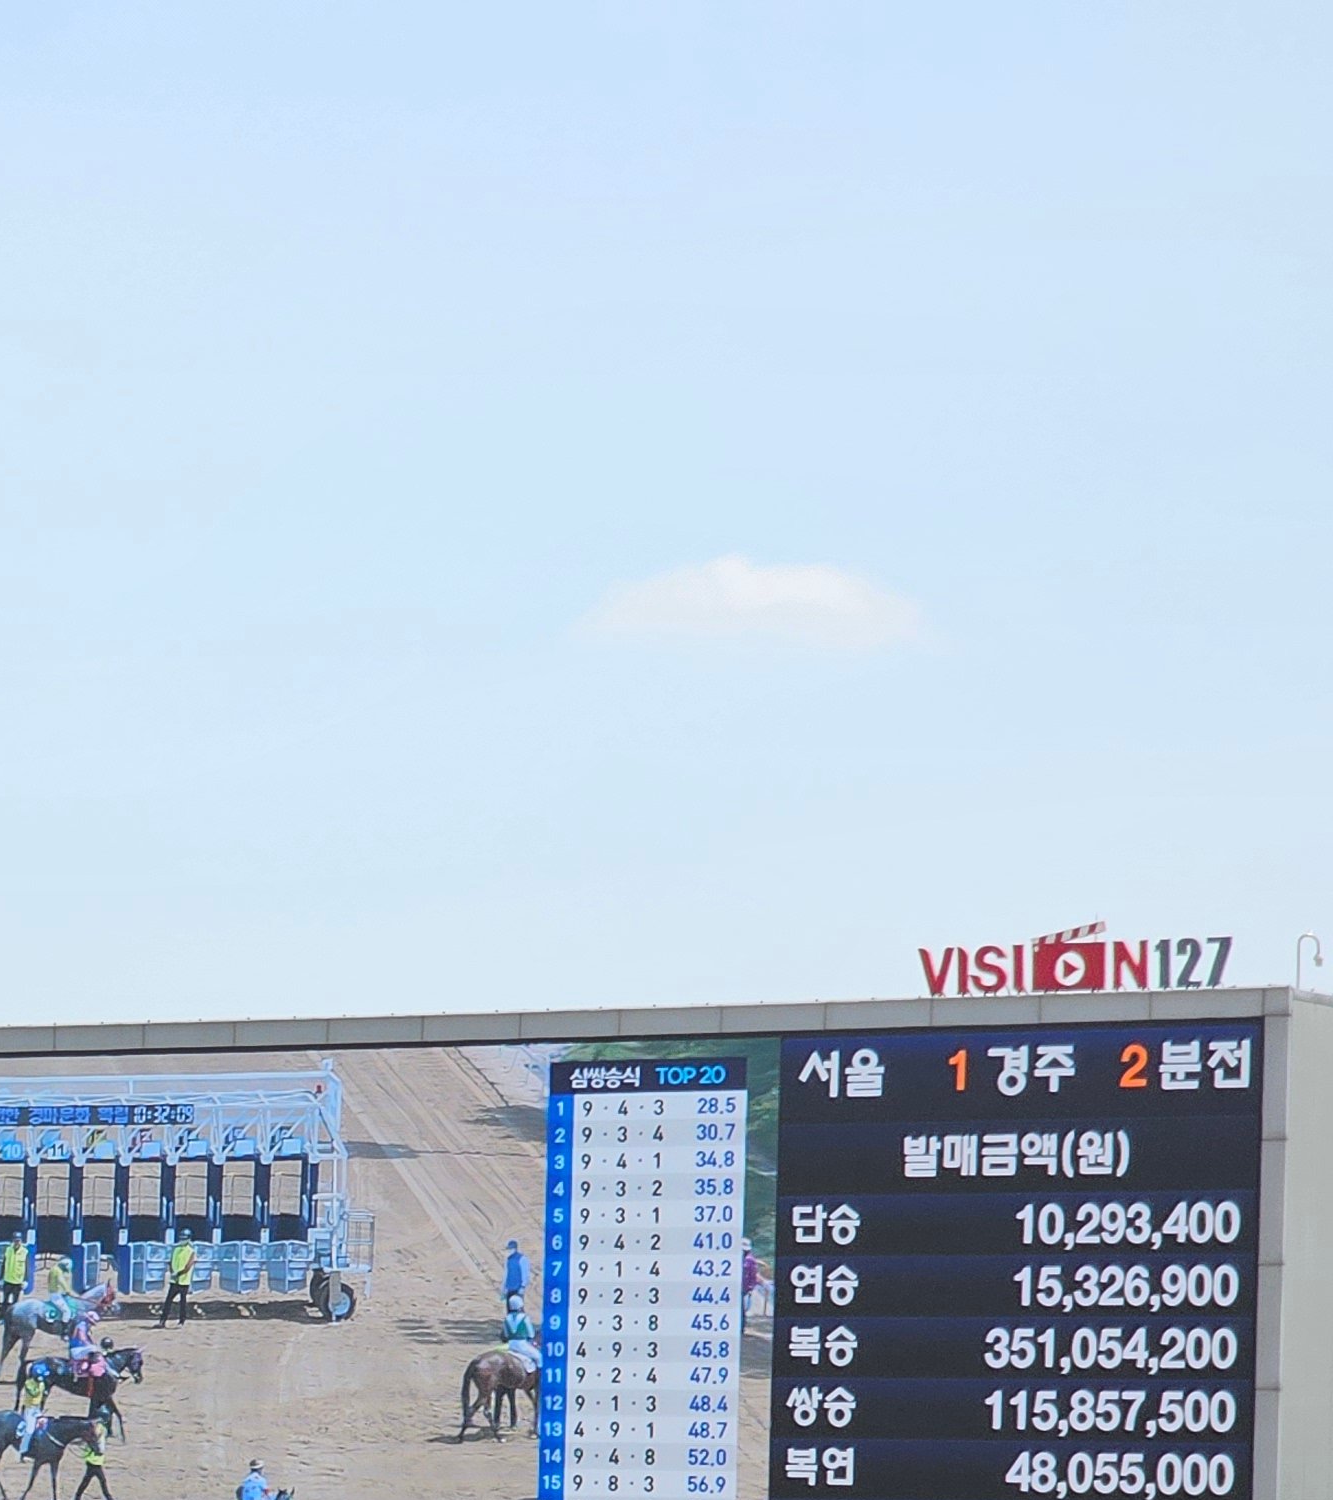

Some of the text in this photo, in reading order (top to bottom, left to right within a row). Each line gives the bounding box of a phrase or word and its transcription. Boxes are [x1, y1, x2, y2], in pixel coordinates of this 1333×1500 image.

[569, 1066, 641, 1088] 삼쌍승식
[798, 1048, 885, 1097] 서울
[949, 1050, 966, 1090] 1
[987, 1043, 1076, 1096] 경주
[697, 1098, 736, 1114] 28.5
[695, 1151, 735, 1168] 34.8
[904, 1129, 1130, 1178] 발매금액(원)
[694, 1206, 733, 1223] 37.0
[793, 1200, 1241, 1250] 단승 10,293,400
[692, 1260, 731, 1277] 43.2
[791, 1264, 1239, 1312] 연승 15,326,900
[789, 1325, 1237, 1375] 복승 351,054,200
[786, 1386, 1236, 1437] 쌍승 115,857,500
[687, 1448, 726, 1466] 52.0
[785, 1447, 1234, 1500] 복연 48,055,000
